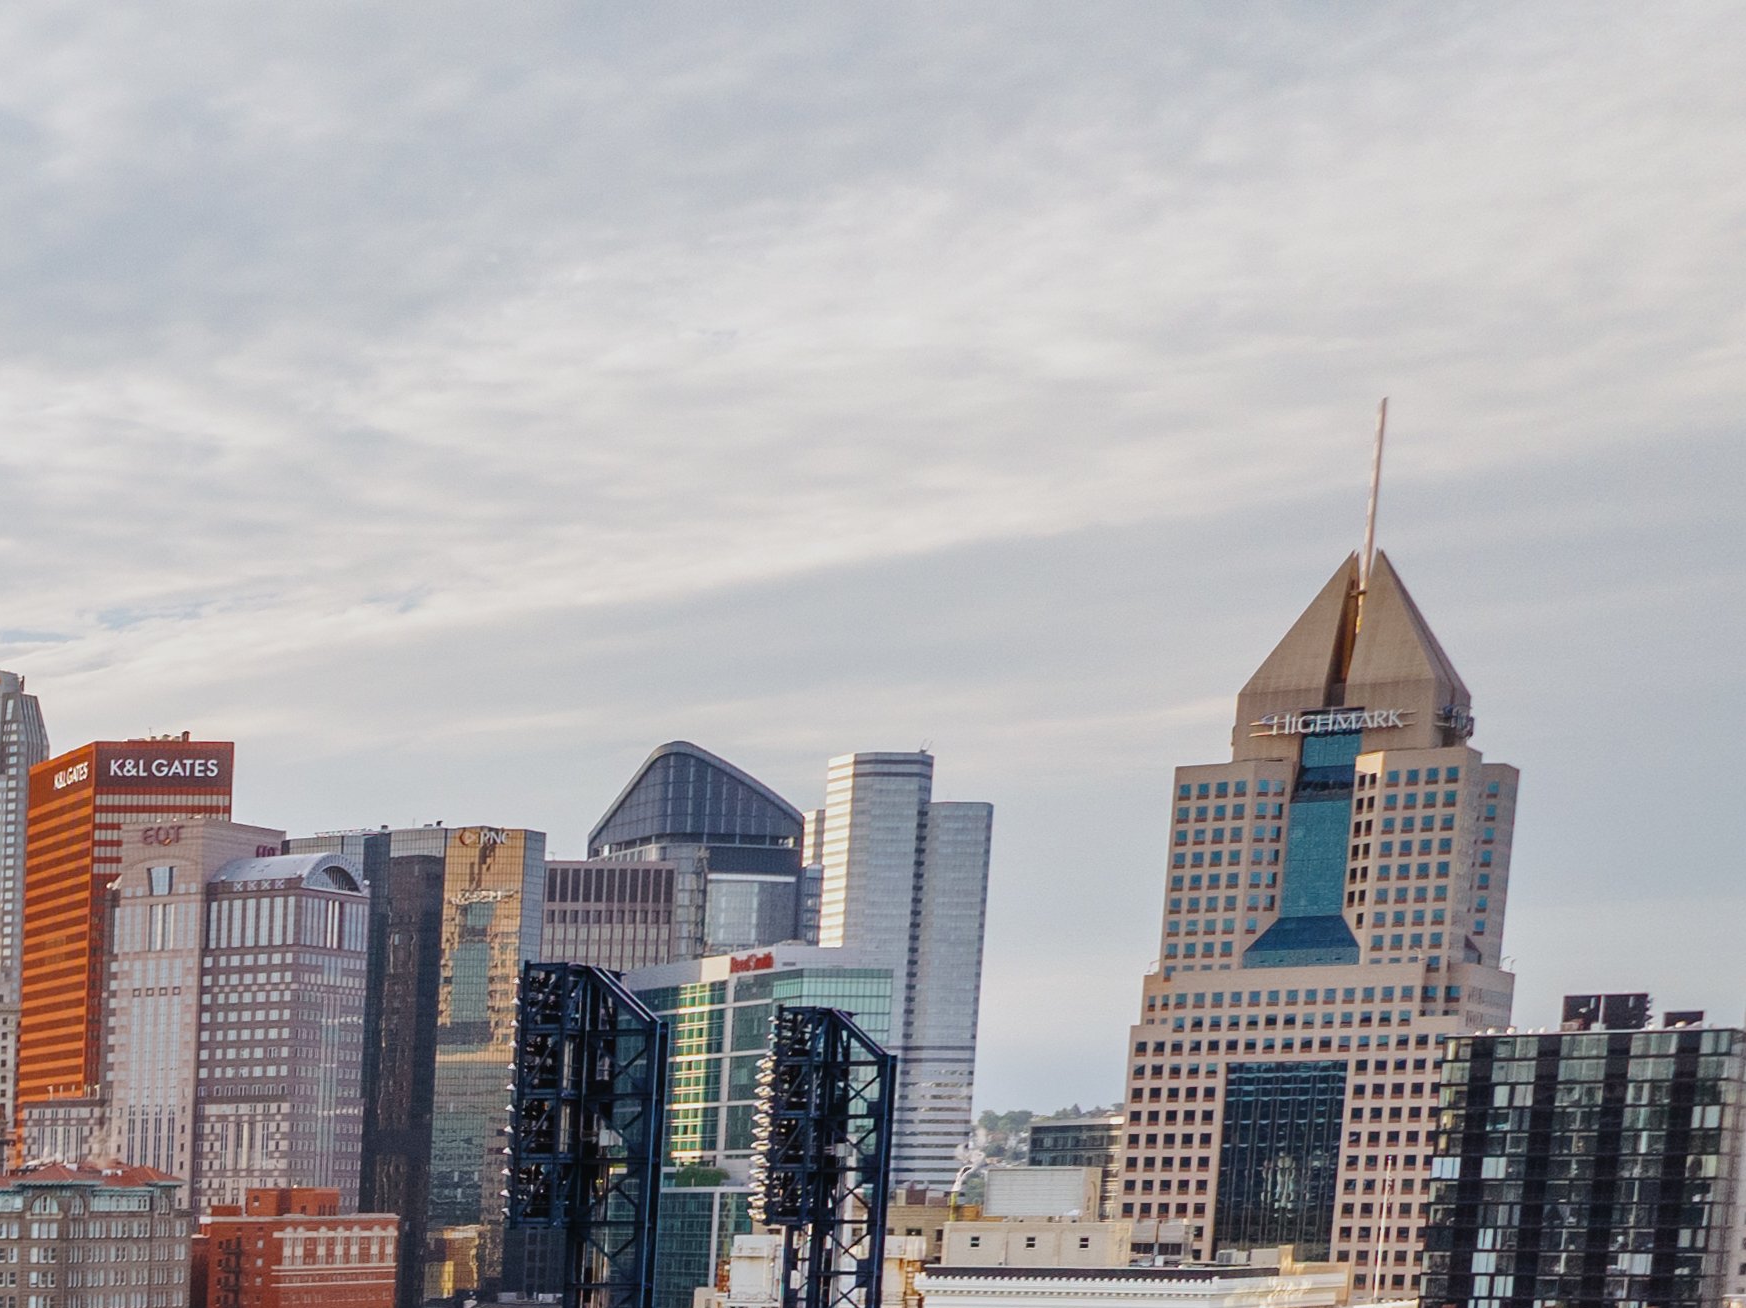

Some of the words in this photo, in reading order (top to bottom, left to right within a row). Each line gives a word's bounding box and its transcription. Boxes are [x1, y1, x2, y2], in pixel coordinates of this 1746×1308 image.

[1269, 708, 1405, 735] HIGHMARK
[65, 761, 89, 787] GATES
[109, 758, 147, 778] K&L
[150, 758, 219, 778] GATES
